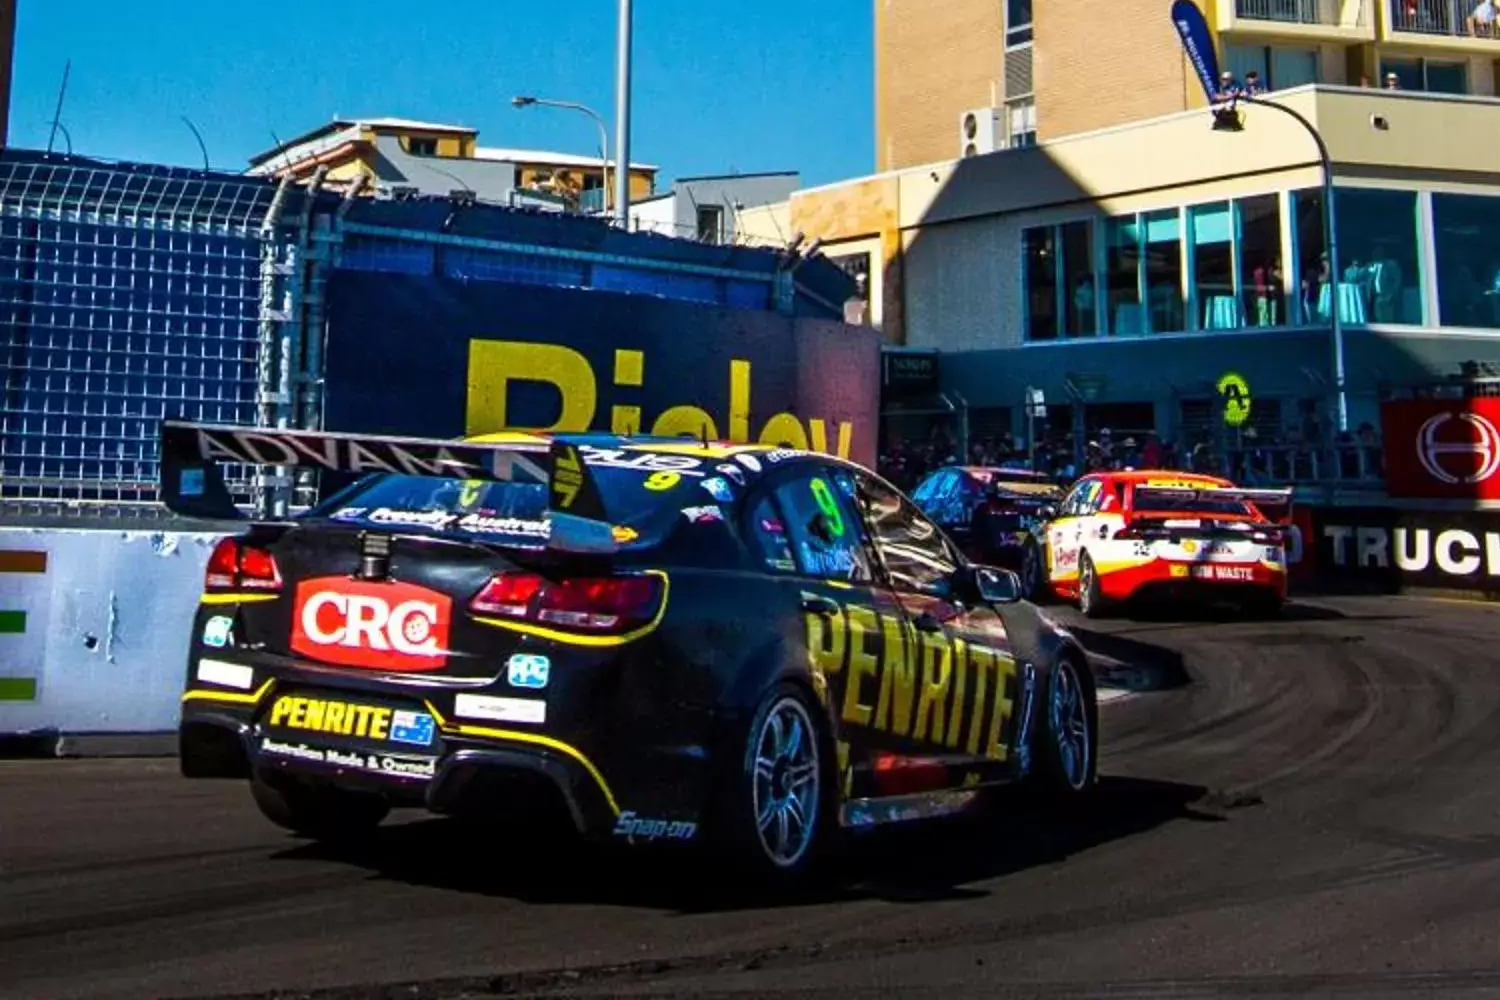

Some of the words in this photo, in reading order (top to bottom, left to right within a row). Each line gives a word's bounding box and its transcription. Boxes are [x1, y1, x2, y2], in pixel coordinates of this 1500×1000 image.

[643, 471, 681, 491] 9
[810, 477, 844, 536] 9
[302, 590, 440, 656] CRC
[804, 603, 1017, 762] PENRITE
[270, 695, 391, 740] PENRITE
[262, 737, 324, 761] Australian
[325, 749, 364, 768] Made
[367, 755, 380, 769] &
[381, 756, 436, 775] Owned
[612, 809, 697, 840] Snap-on
